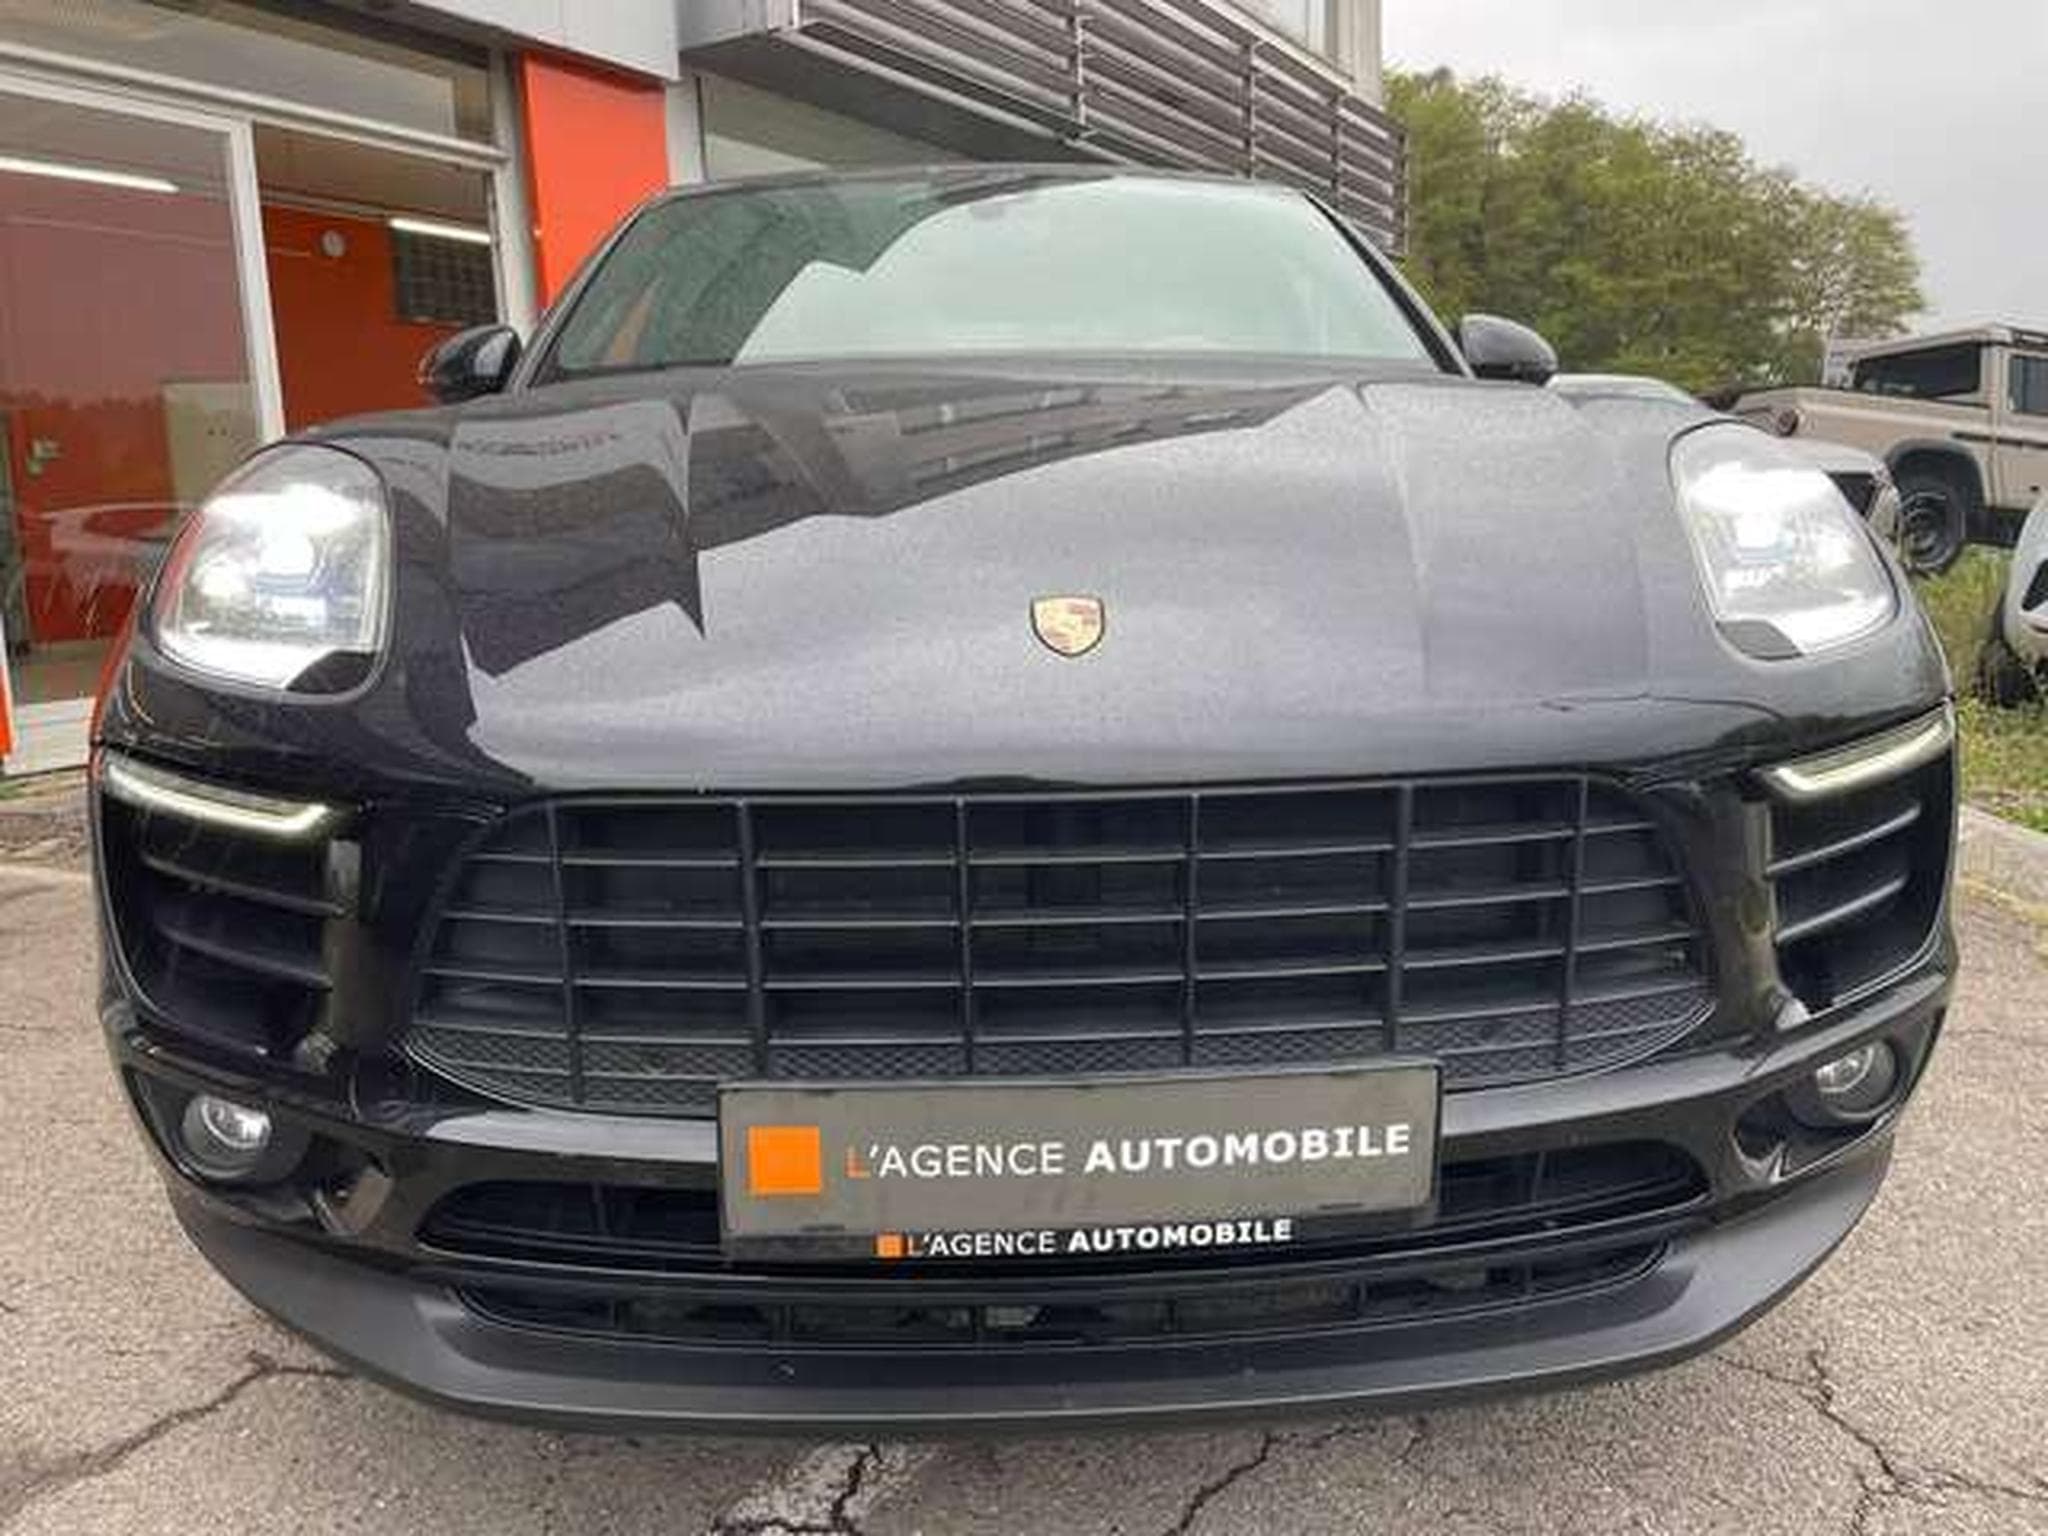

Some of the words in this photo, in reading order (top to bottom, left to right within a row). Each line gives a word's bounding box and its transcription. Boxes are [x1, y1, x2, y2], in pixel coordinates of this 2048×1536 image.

[846, 1143, 1065, 1178] L'AGENCE
[1084, 1123, 1411, 1174] AUTOMOBILE
[907, 1231, 1055, 1257] L'AGENCE
[1068, 1219, 1292, 1253] AUTOMOBILE
